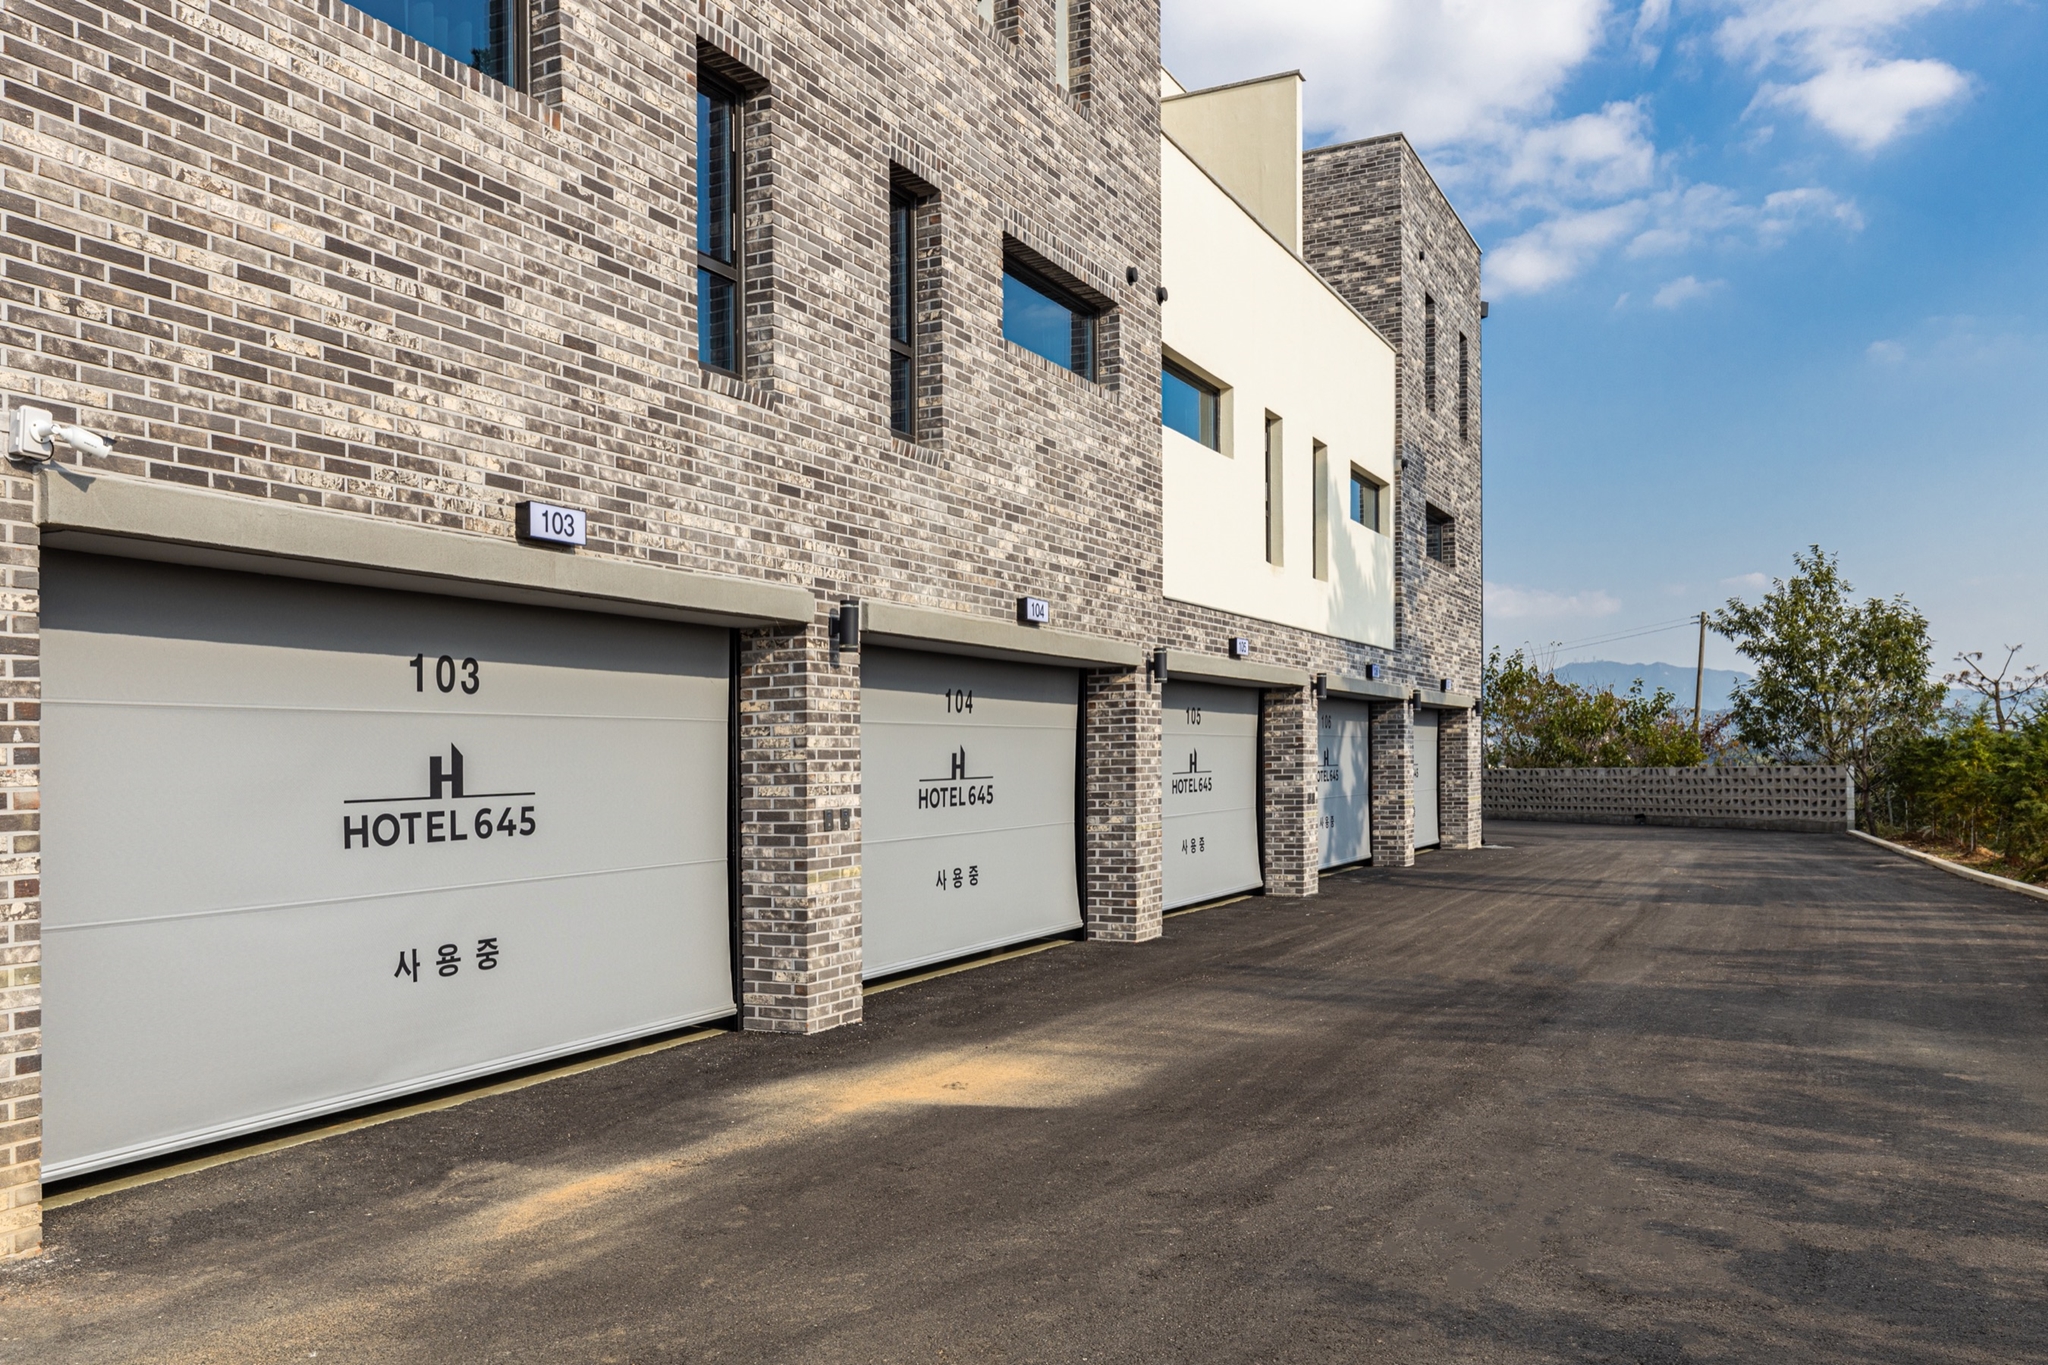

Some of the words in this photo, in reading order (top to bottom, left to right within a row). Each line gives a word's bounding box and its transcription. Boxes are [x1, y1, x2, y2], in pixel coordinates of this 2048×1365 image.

[541, 509, 576, 537] 103
[1031, 602, 1045, 619] 104
[1238, 641, 1247, 653] 105
[409, 653, 480, 695] 103
[945, 688, 973, 714] 104
[1186, 707, 1201, 726] 105
[1171, 778, 1198, 795] HOTEL
[1198, 776, 1213, 793] 645
[1317, 770, 1329, 782] OTEL
[1329, 769, 1339, 781] 645
[918, 786, 966, 810] HOTEL
[968, 784, 994, 806] 645
[343, 809, 468, 850] HOTEL
[473, 805, 537, 840] 645
[1181, 836, 1205, 855] 사용중
[936, 865, 979, 891] 사용중
[393, 937, 500, 983] 사용중
